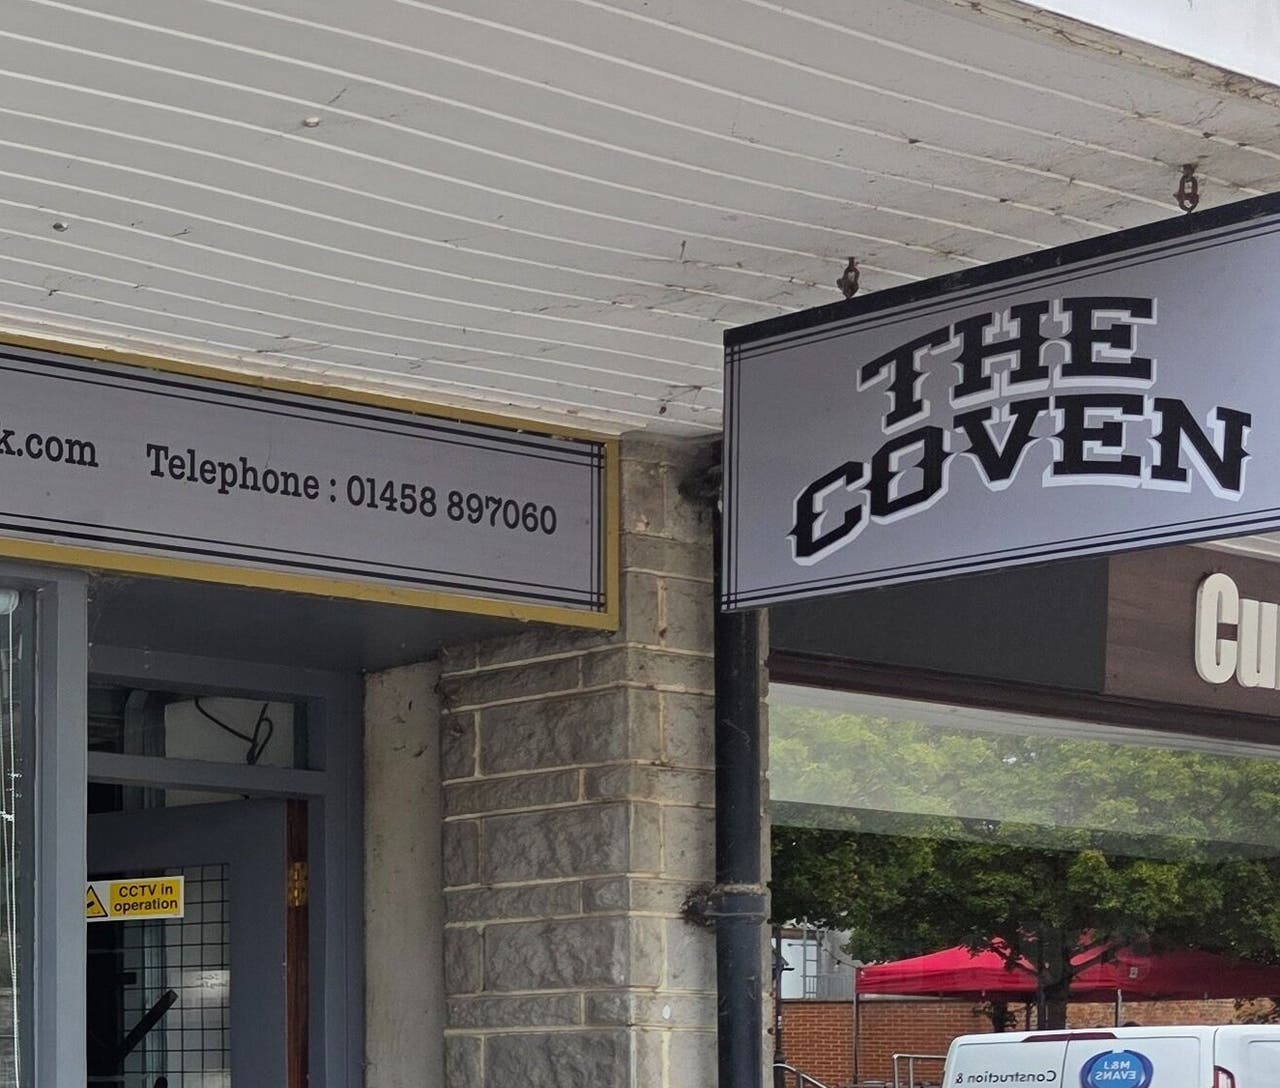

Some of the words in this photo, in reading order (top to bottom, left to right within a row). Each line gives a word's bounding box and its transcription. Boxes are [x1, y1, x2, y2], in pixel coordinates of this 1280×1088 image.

[857, 296, 1157, 435] THE
[146, 443, 320, 500] Telephone
[346, 474, 437, 518] 01458
[446, 490, 557, 536] 897060
[787, 393, 1253, 567] COVEN
[113, 898, 178, 915] operation
[118, 884, 157, 898] CCTV
[161, 883, 173, 895] in
